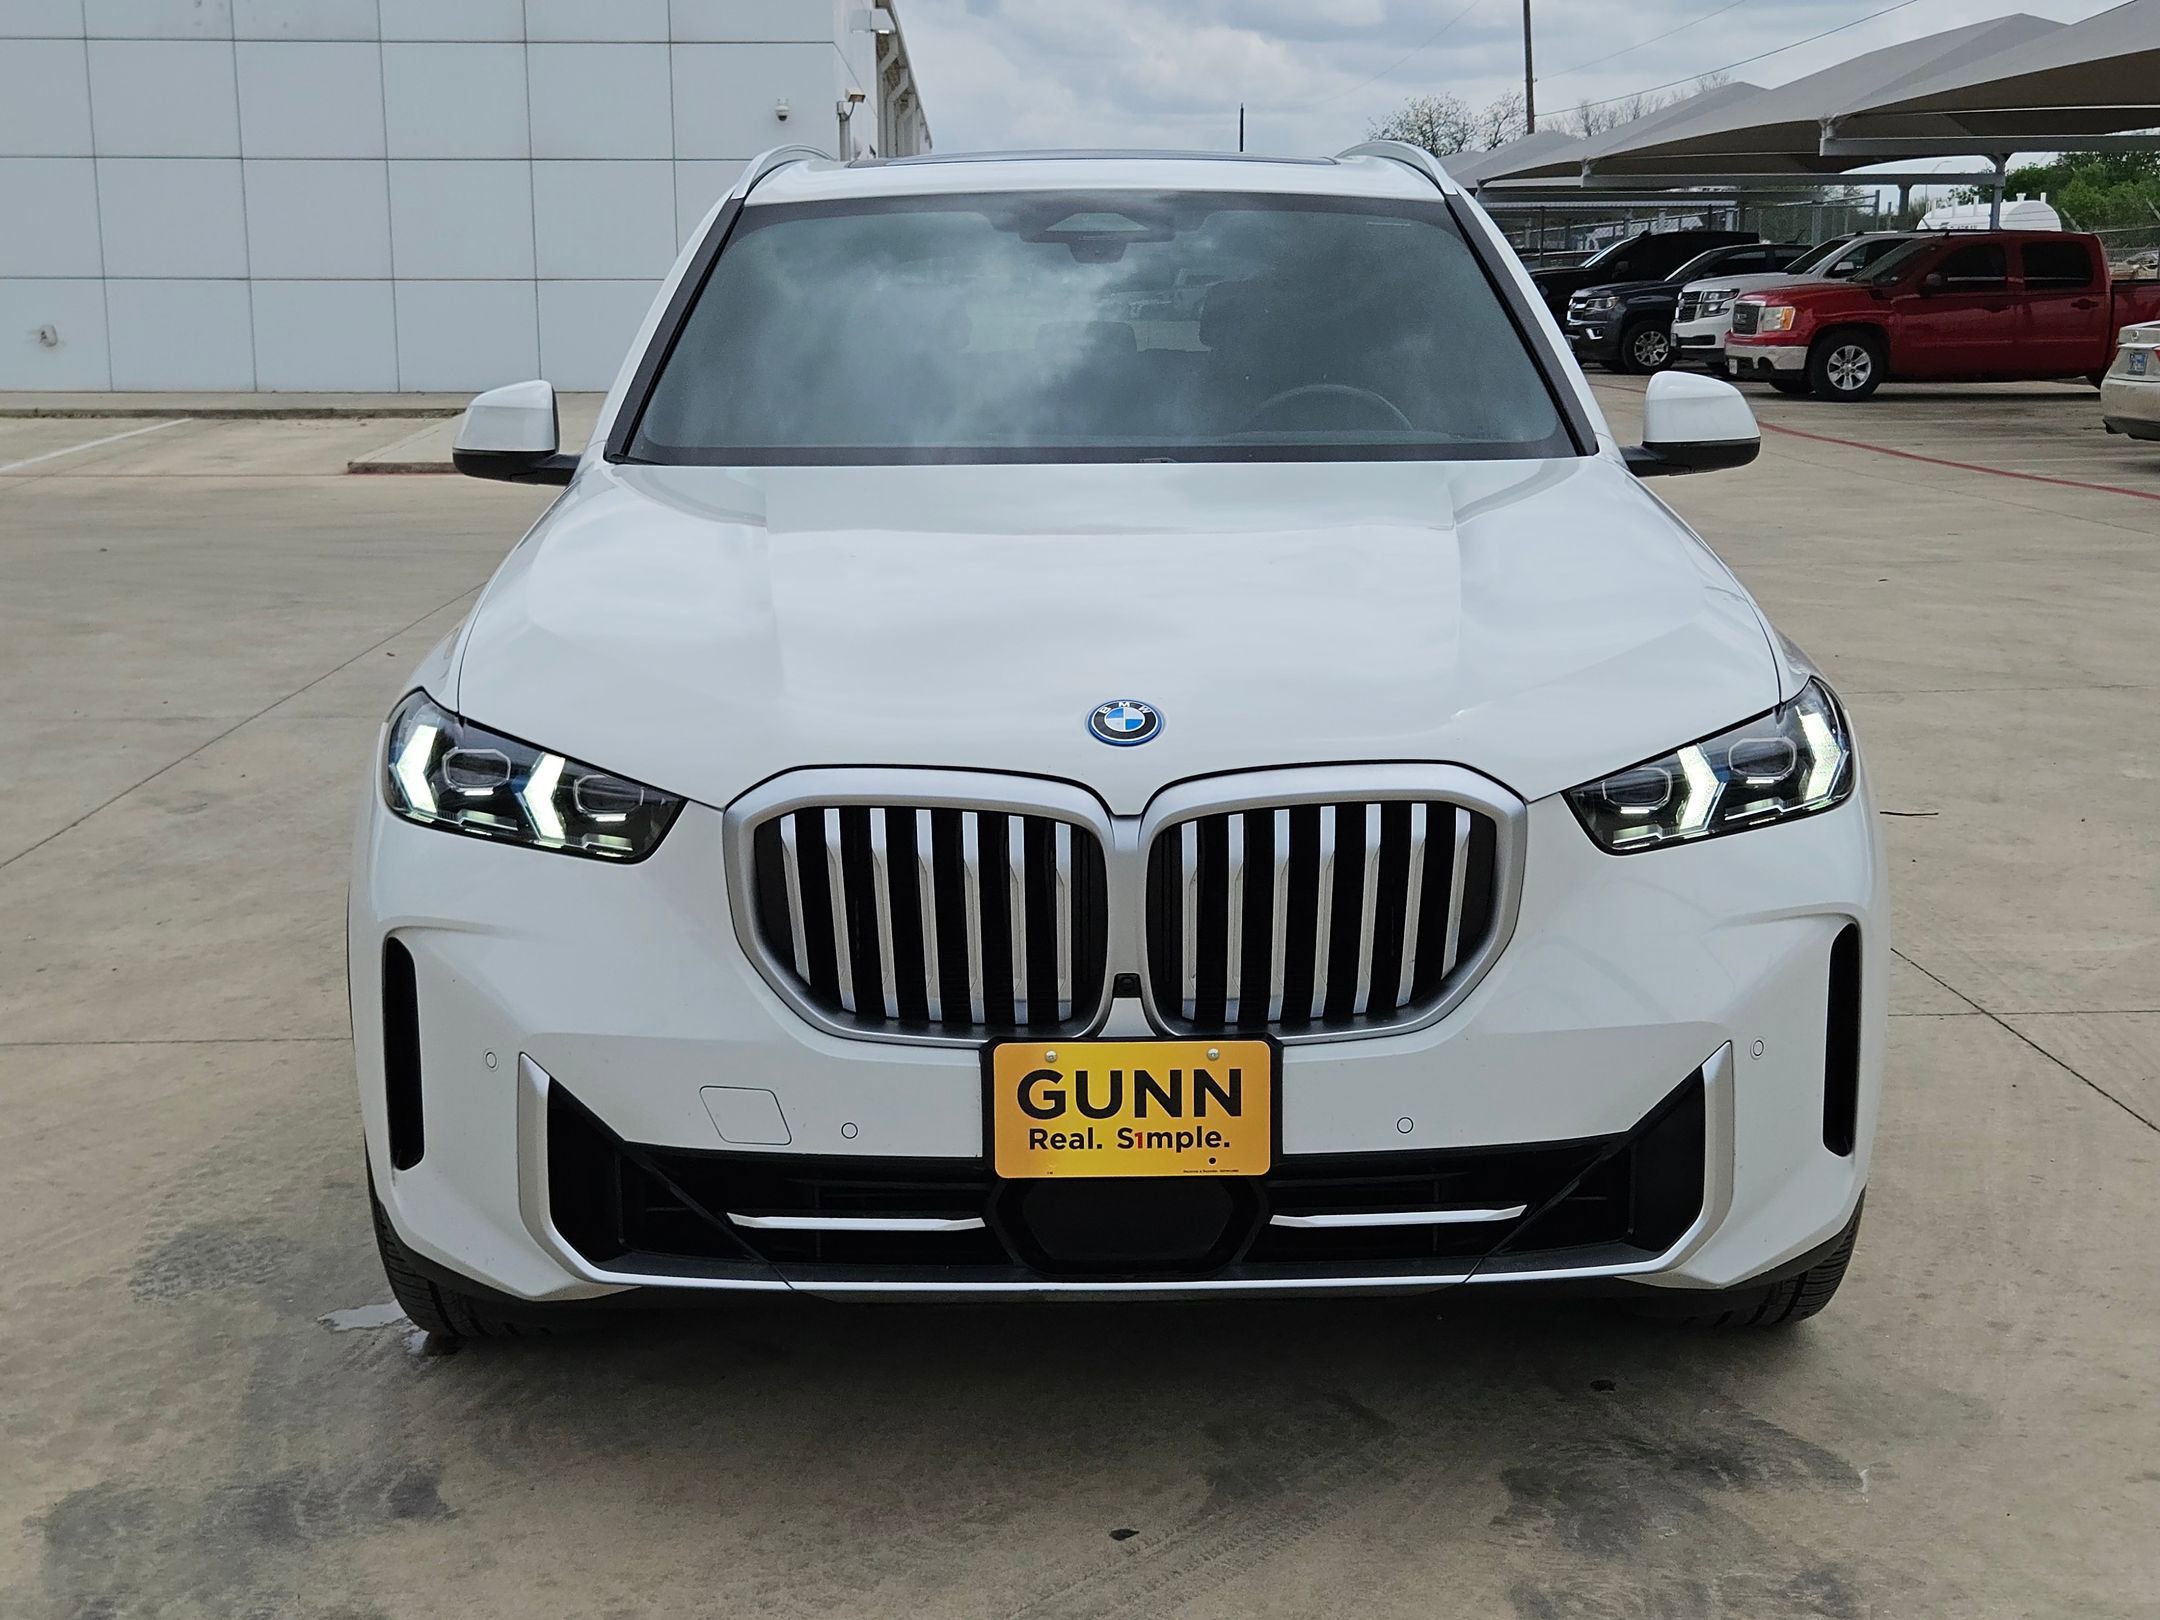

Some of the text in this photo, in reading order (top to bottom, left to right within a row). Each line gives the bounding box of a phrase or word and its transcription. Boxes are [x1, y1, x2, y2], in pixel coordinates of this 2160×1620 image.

[1099, 701, 1152, 714] BMW
[1017, 1068, 1242, 1119] GUNN
[1029, 1127, 1103, 1150] Real.
